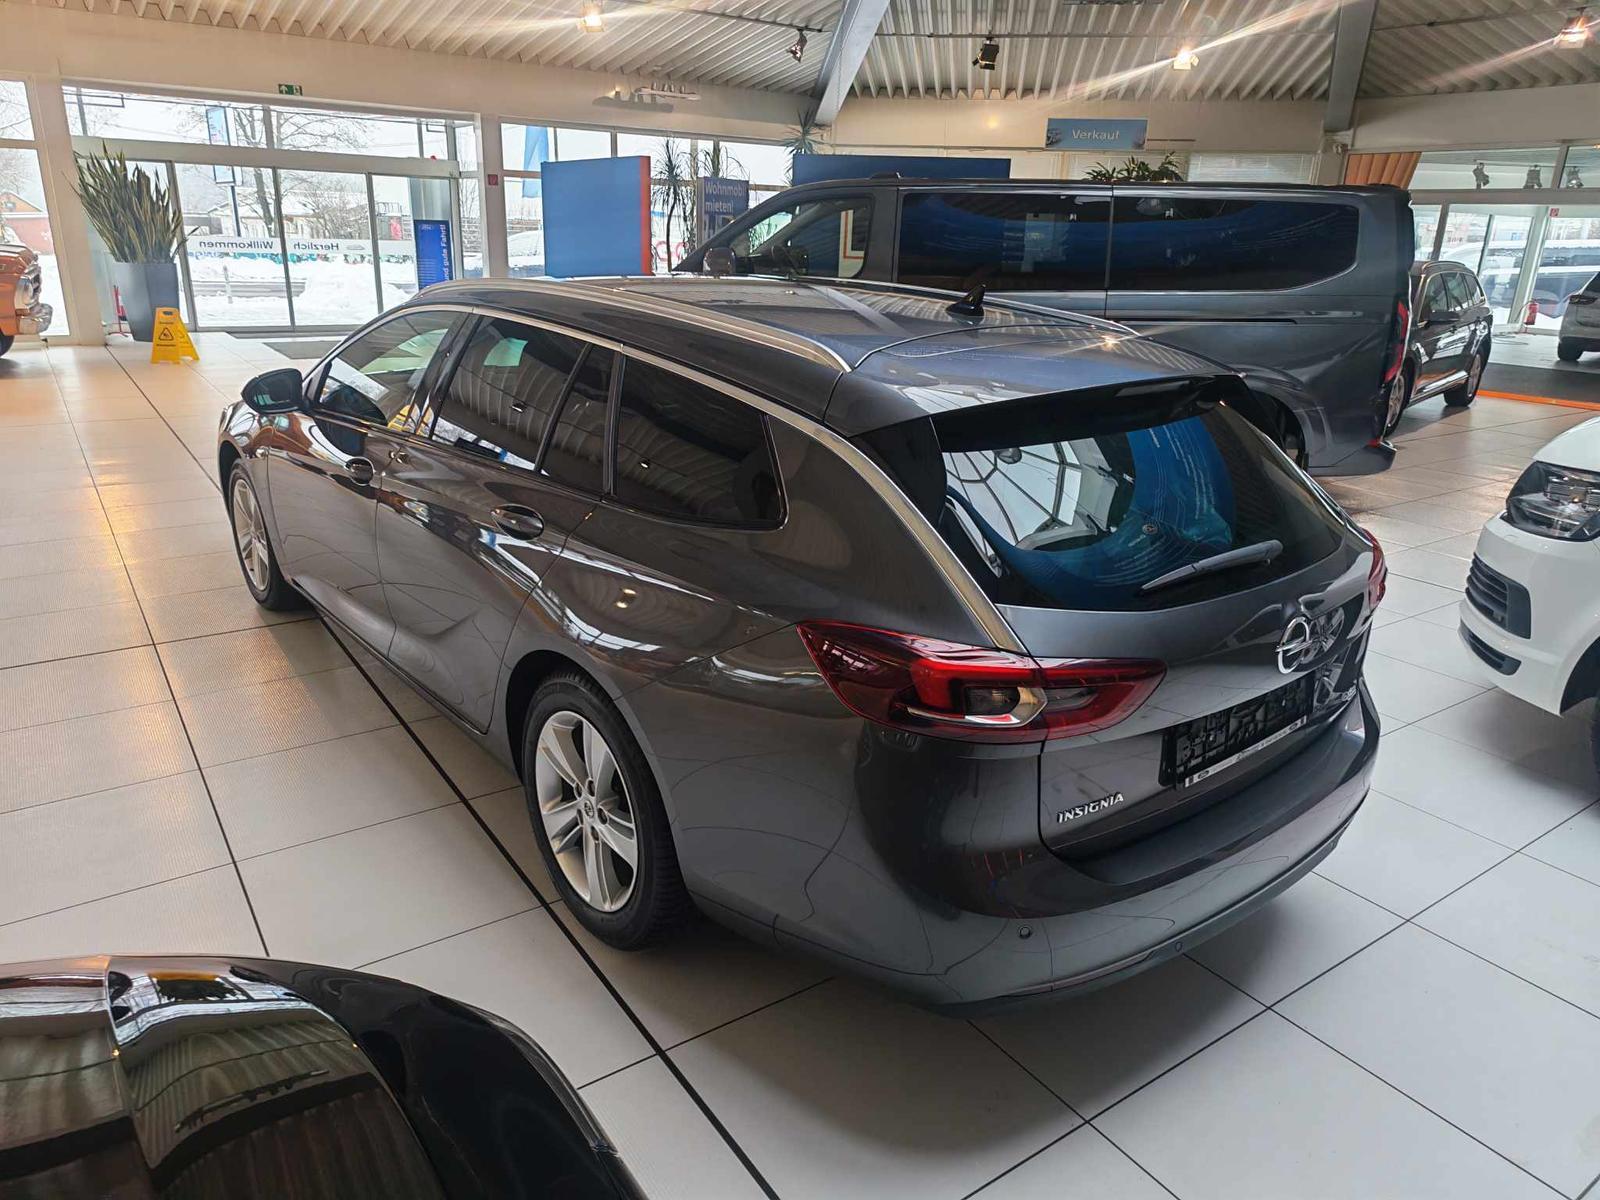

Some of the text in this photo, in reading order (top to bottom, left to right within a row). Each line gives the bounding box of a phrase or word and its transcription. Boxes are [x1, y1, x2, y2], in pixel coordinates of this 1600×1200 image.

[1071, 128, 1120, 140] Verkauf
[705, 182, 747, 197] Wohnmobil
[1057, 793, 1124, 823] INSIGNIA
